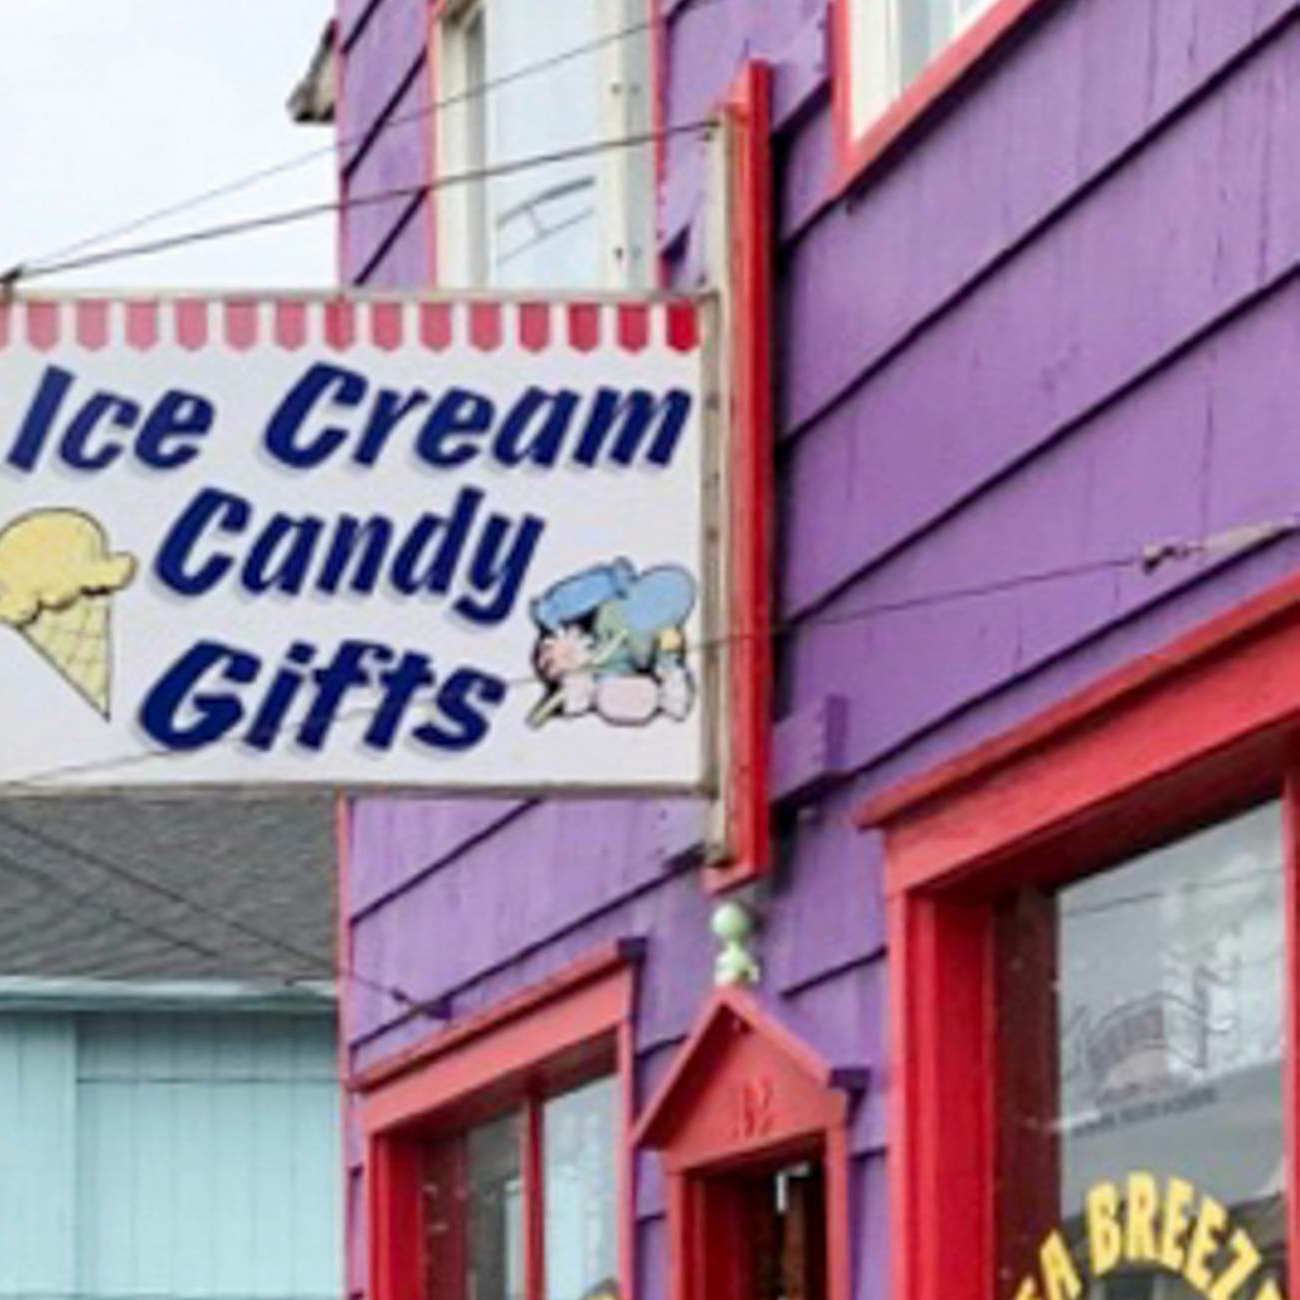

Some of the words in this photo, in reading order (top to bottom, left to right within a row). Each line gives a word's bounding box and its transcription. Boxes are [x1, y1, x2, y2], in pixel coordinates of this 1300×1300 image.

[6, 364, 215, 472] Ice
[264, 360, 692, 470] Cream
[152, 485, 545, 626] Candy
[137, 637, 507, 752] Gifts
